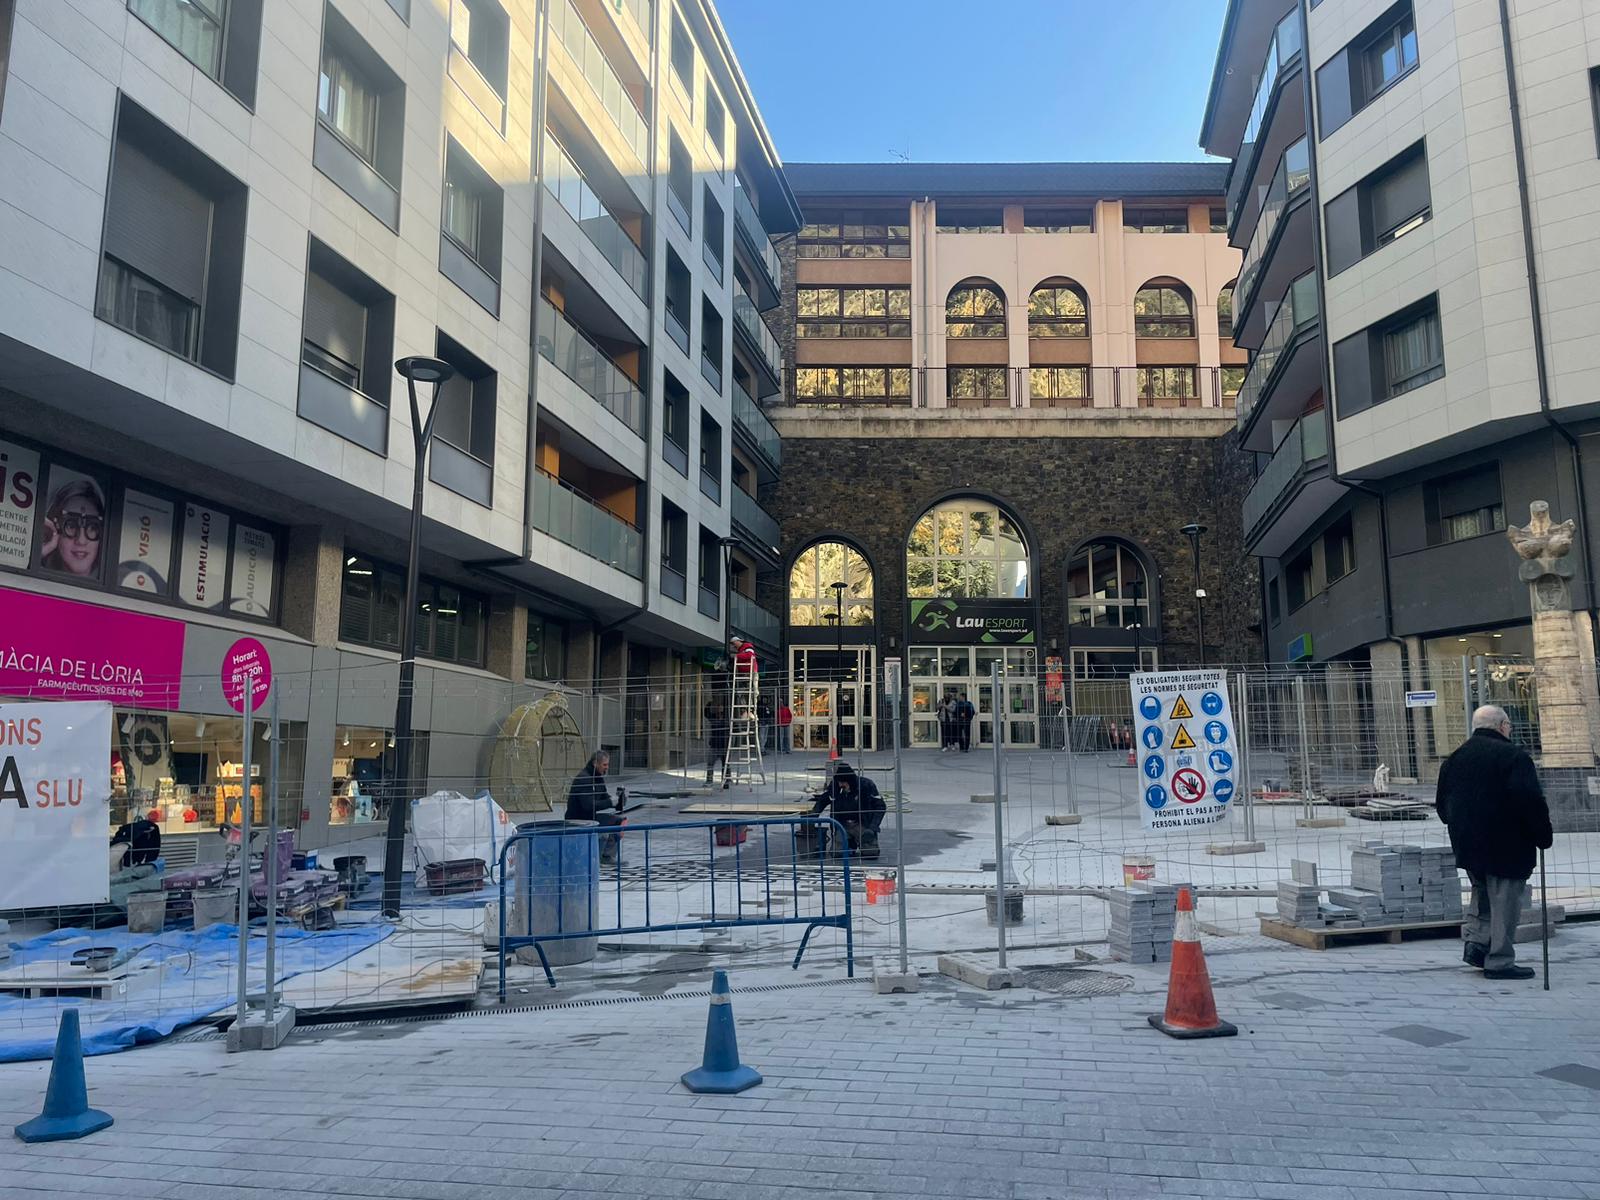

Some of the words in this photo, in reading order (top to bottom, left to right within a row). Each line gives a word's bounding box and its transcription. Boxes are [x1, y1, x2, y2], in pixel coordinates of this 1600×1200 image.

[985, 617, 1027, 628] ESPORT
[60, 658, 87, 679] DE
[91, 660, 144, 685] LÒRIA
[248, 666, 263, 677] 20h
[1146, 676, 1181, 685] OBLIGATORI
[1182, 674, 1202, 682] SEGUIR
[1140, 686, 1152, 694] LES
[1153, 684, 1178, 693] NORMES
[1187, 682, 1218, 691] SEGURETAT
[36, 778, 83, 808] SLU
[1154, 808, 1184, 818] PROHIBIT
[1186, 807, 1194, 815] EL
[1195, 806, 1207, 814] PAS
[1151, 819, 1182, 828] PERSONA
[1183, 817, 1206, 826] ALIENA
